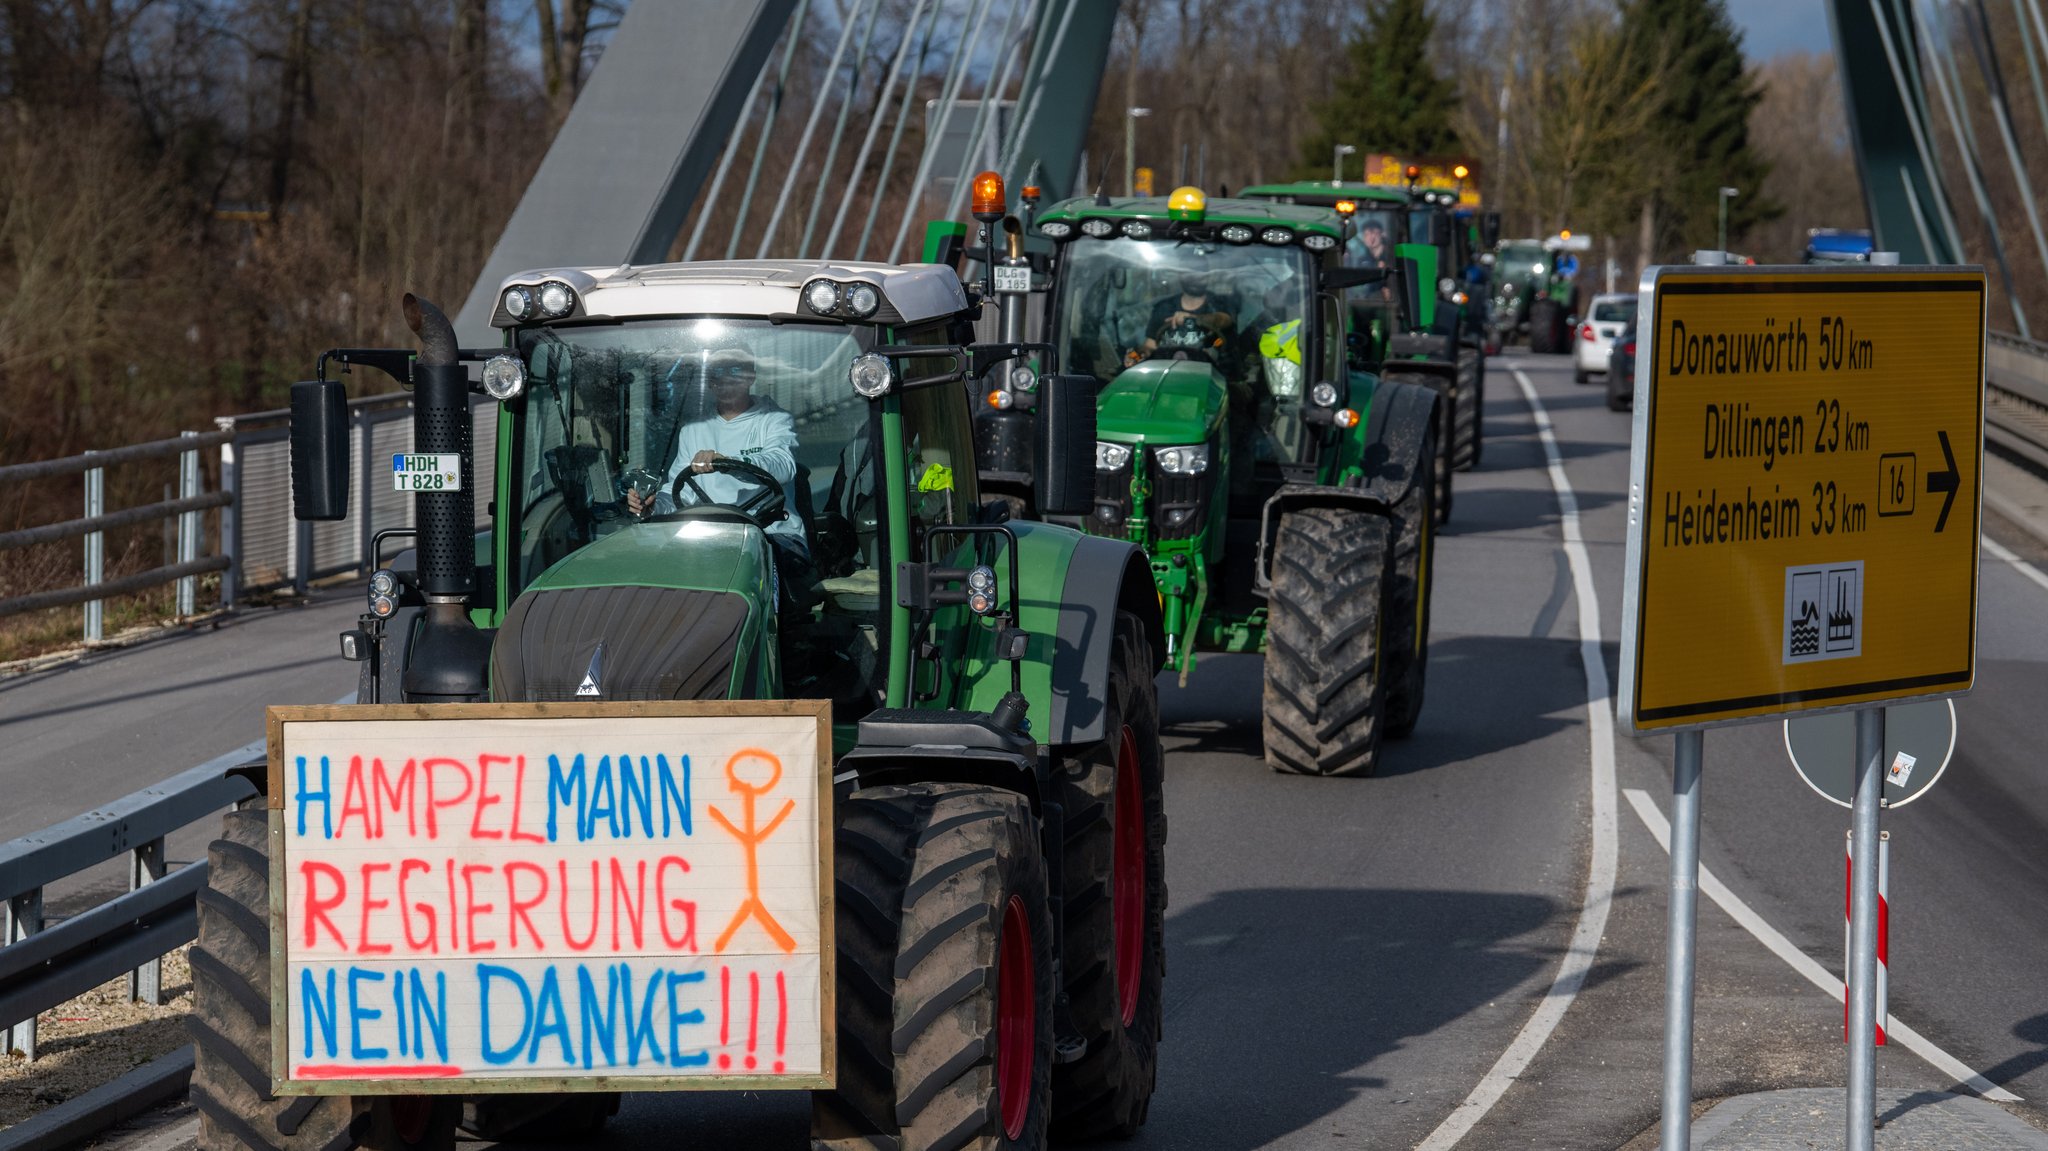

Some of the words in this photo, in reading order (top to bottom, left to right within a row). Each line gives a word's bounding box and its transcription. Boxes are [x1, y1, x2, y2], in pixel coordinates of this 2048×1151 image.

[1669, 317, 1808, 377] Donauwörth
[1819, 316, 1845, 371] 50
[1849, 329, 1873, 370] km
[405, 456, 438, 472] HDH
[1703, 402, 1804, 472] Dillingen
[1814, 398, 1841, 453] 23
[1845, 411, 1870, 451] km
[398, 475, 407, 489] T
[413, 473, 444, 489] 828
[1664, 485, 1800, 547] Heidenheim
[1811, 480, 1838, 536] 33
[1841, 493, 1867, 534] km
[1888, 464, 1905, 506] 16
[294, 752, 694, 844] HAMPELMANN
[300, 855, 700, 954] REGIERUNG
[300, 966, 449, 1063] NEIN
[476, 961, 787, 1074] DANKE!!!
